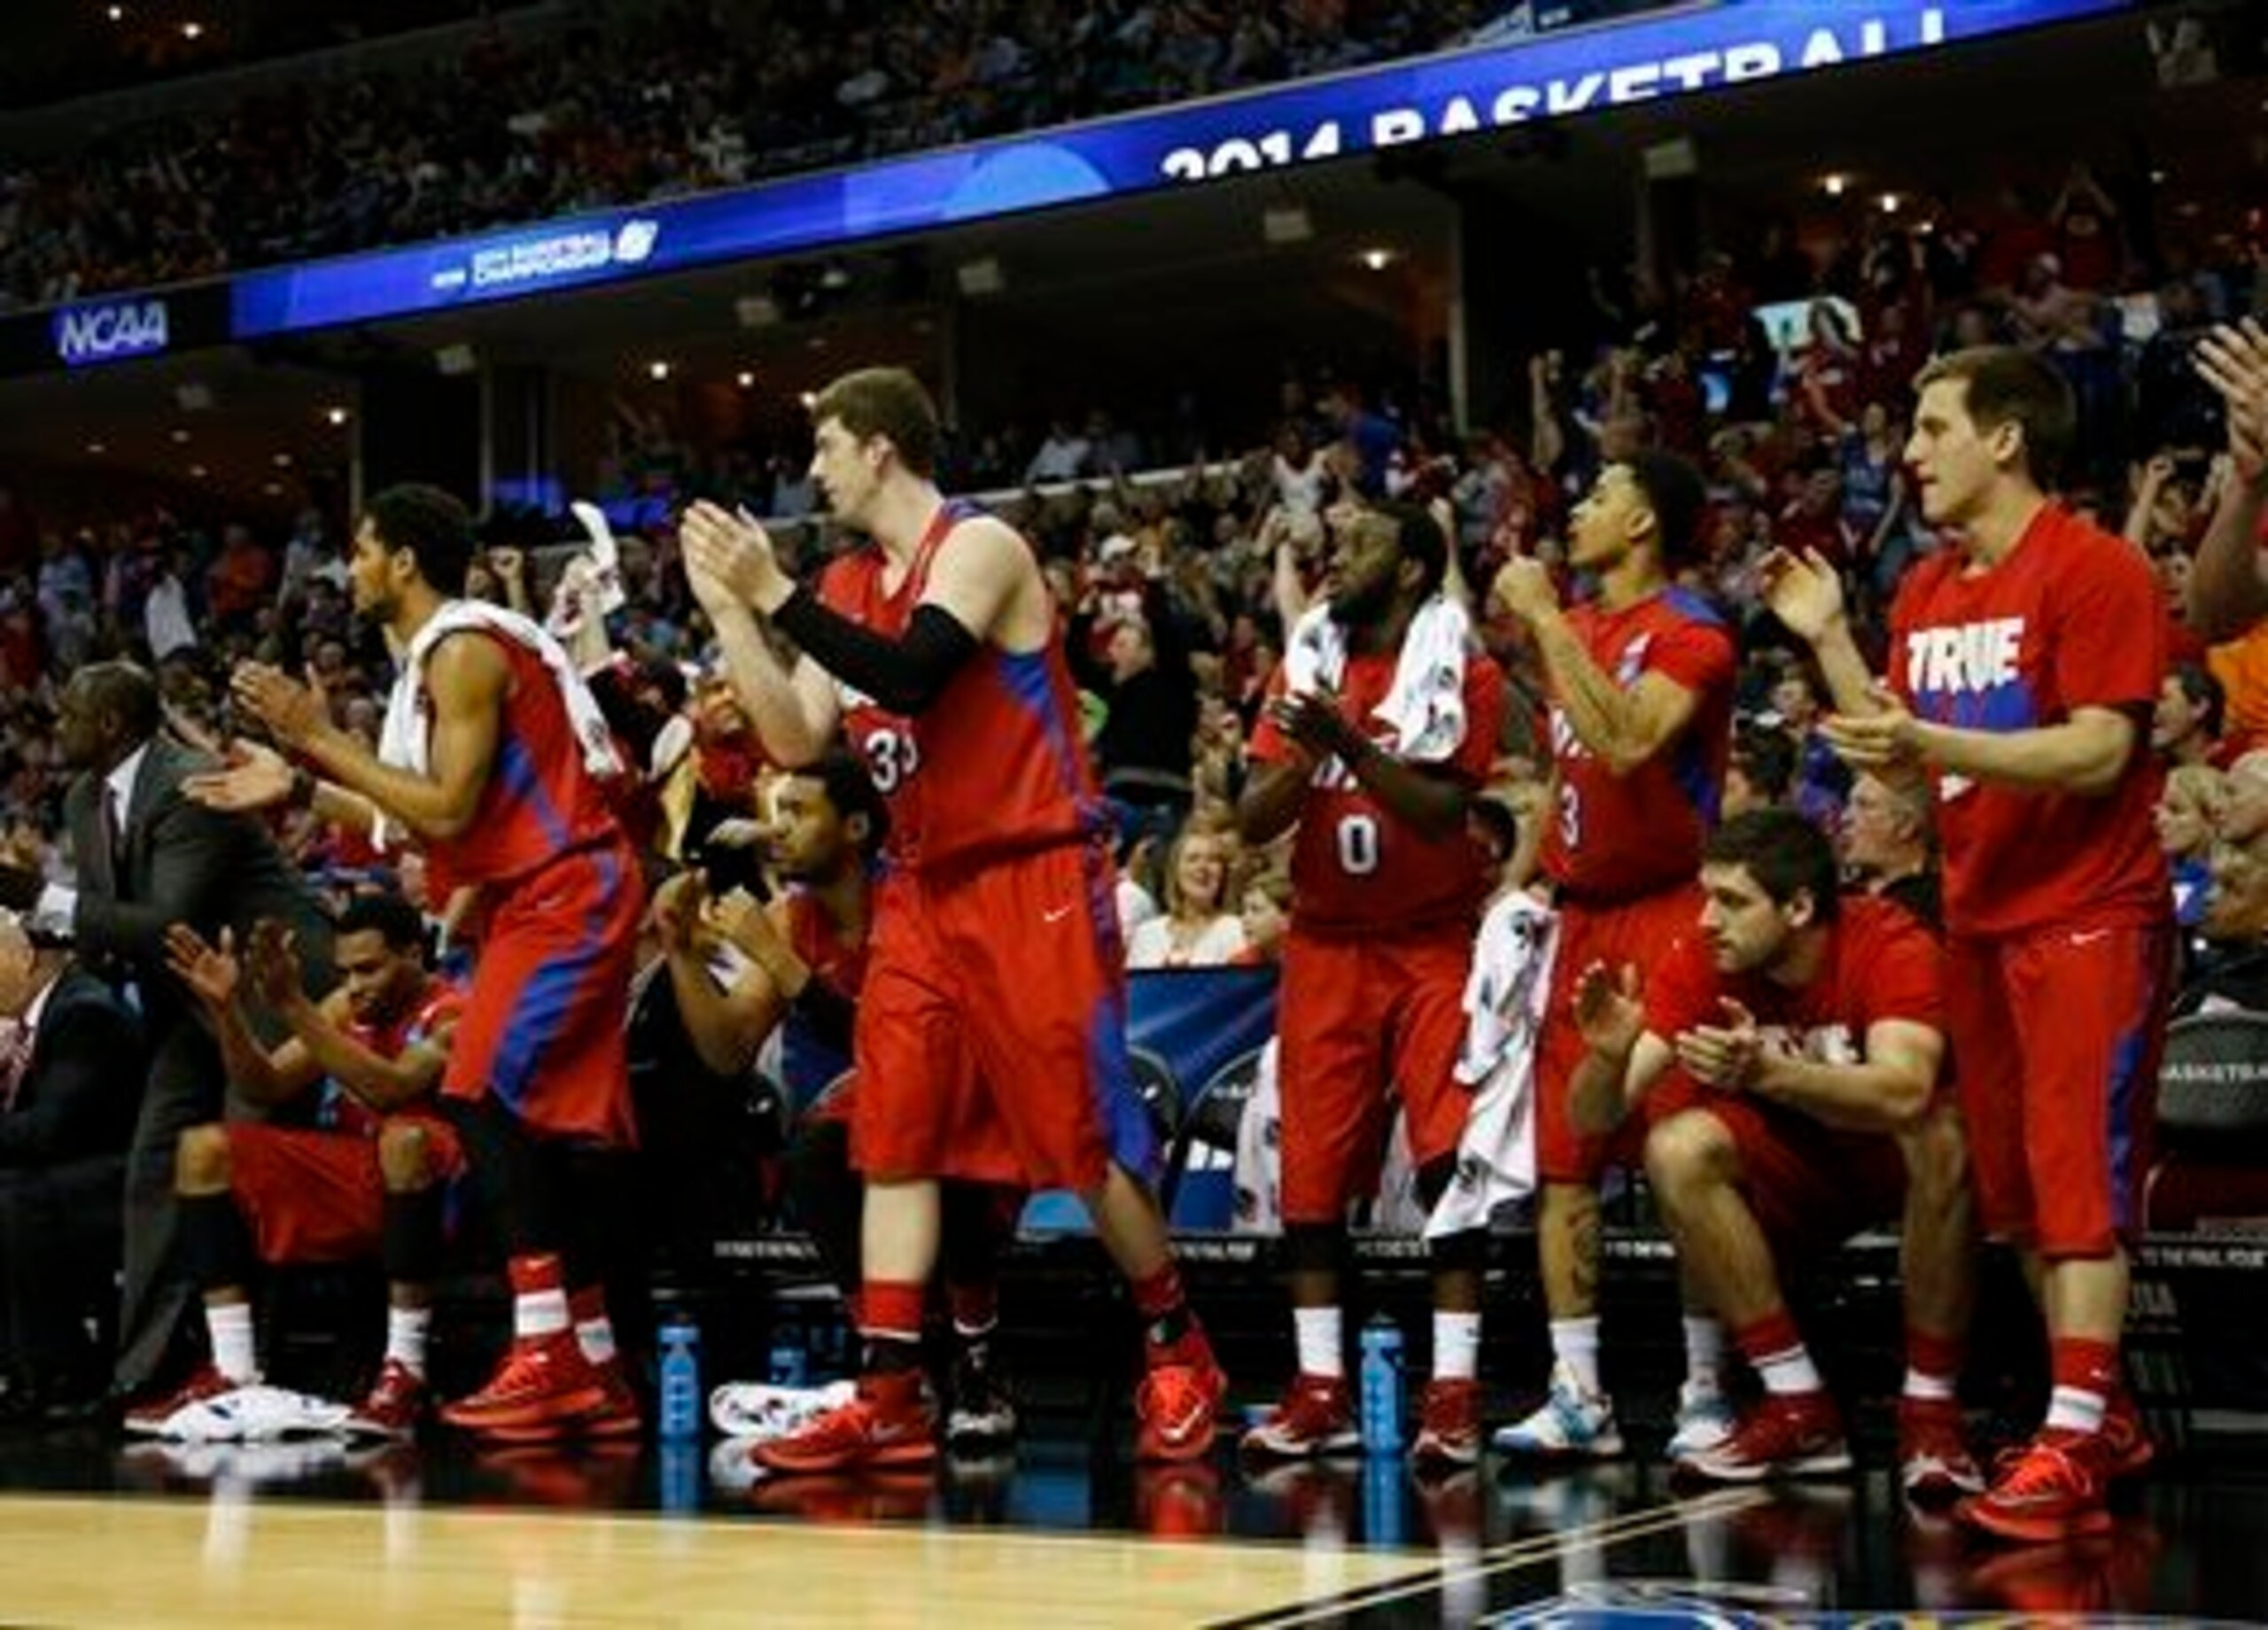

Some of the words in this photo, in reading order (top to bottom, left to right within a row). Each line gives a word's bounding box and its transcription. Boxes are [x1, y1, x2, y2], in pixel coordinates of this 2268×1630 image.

[58, 302, 167, 355] NCAA
[1907, 616, 2025, 696] TRUE
[1338, 814, 1377, 873] 0
